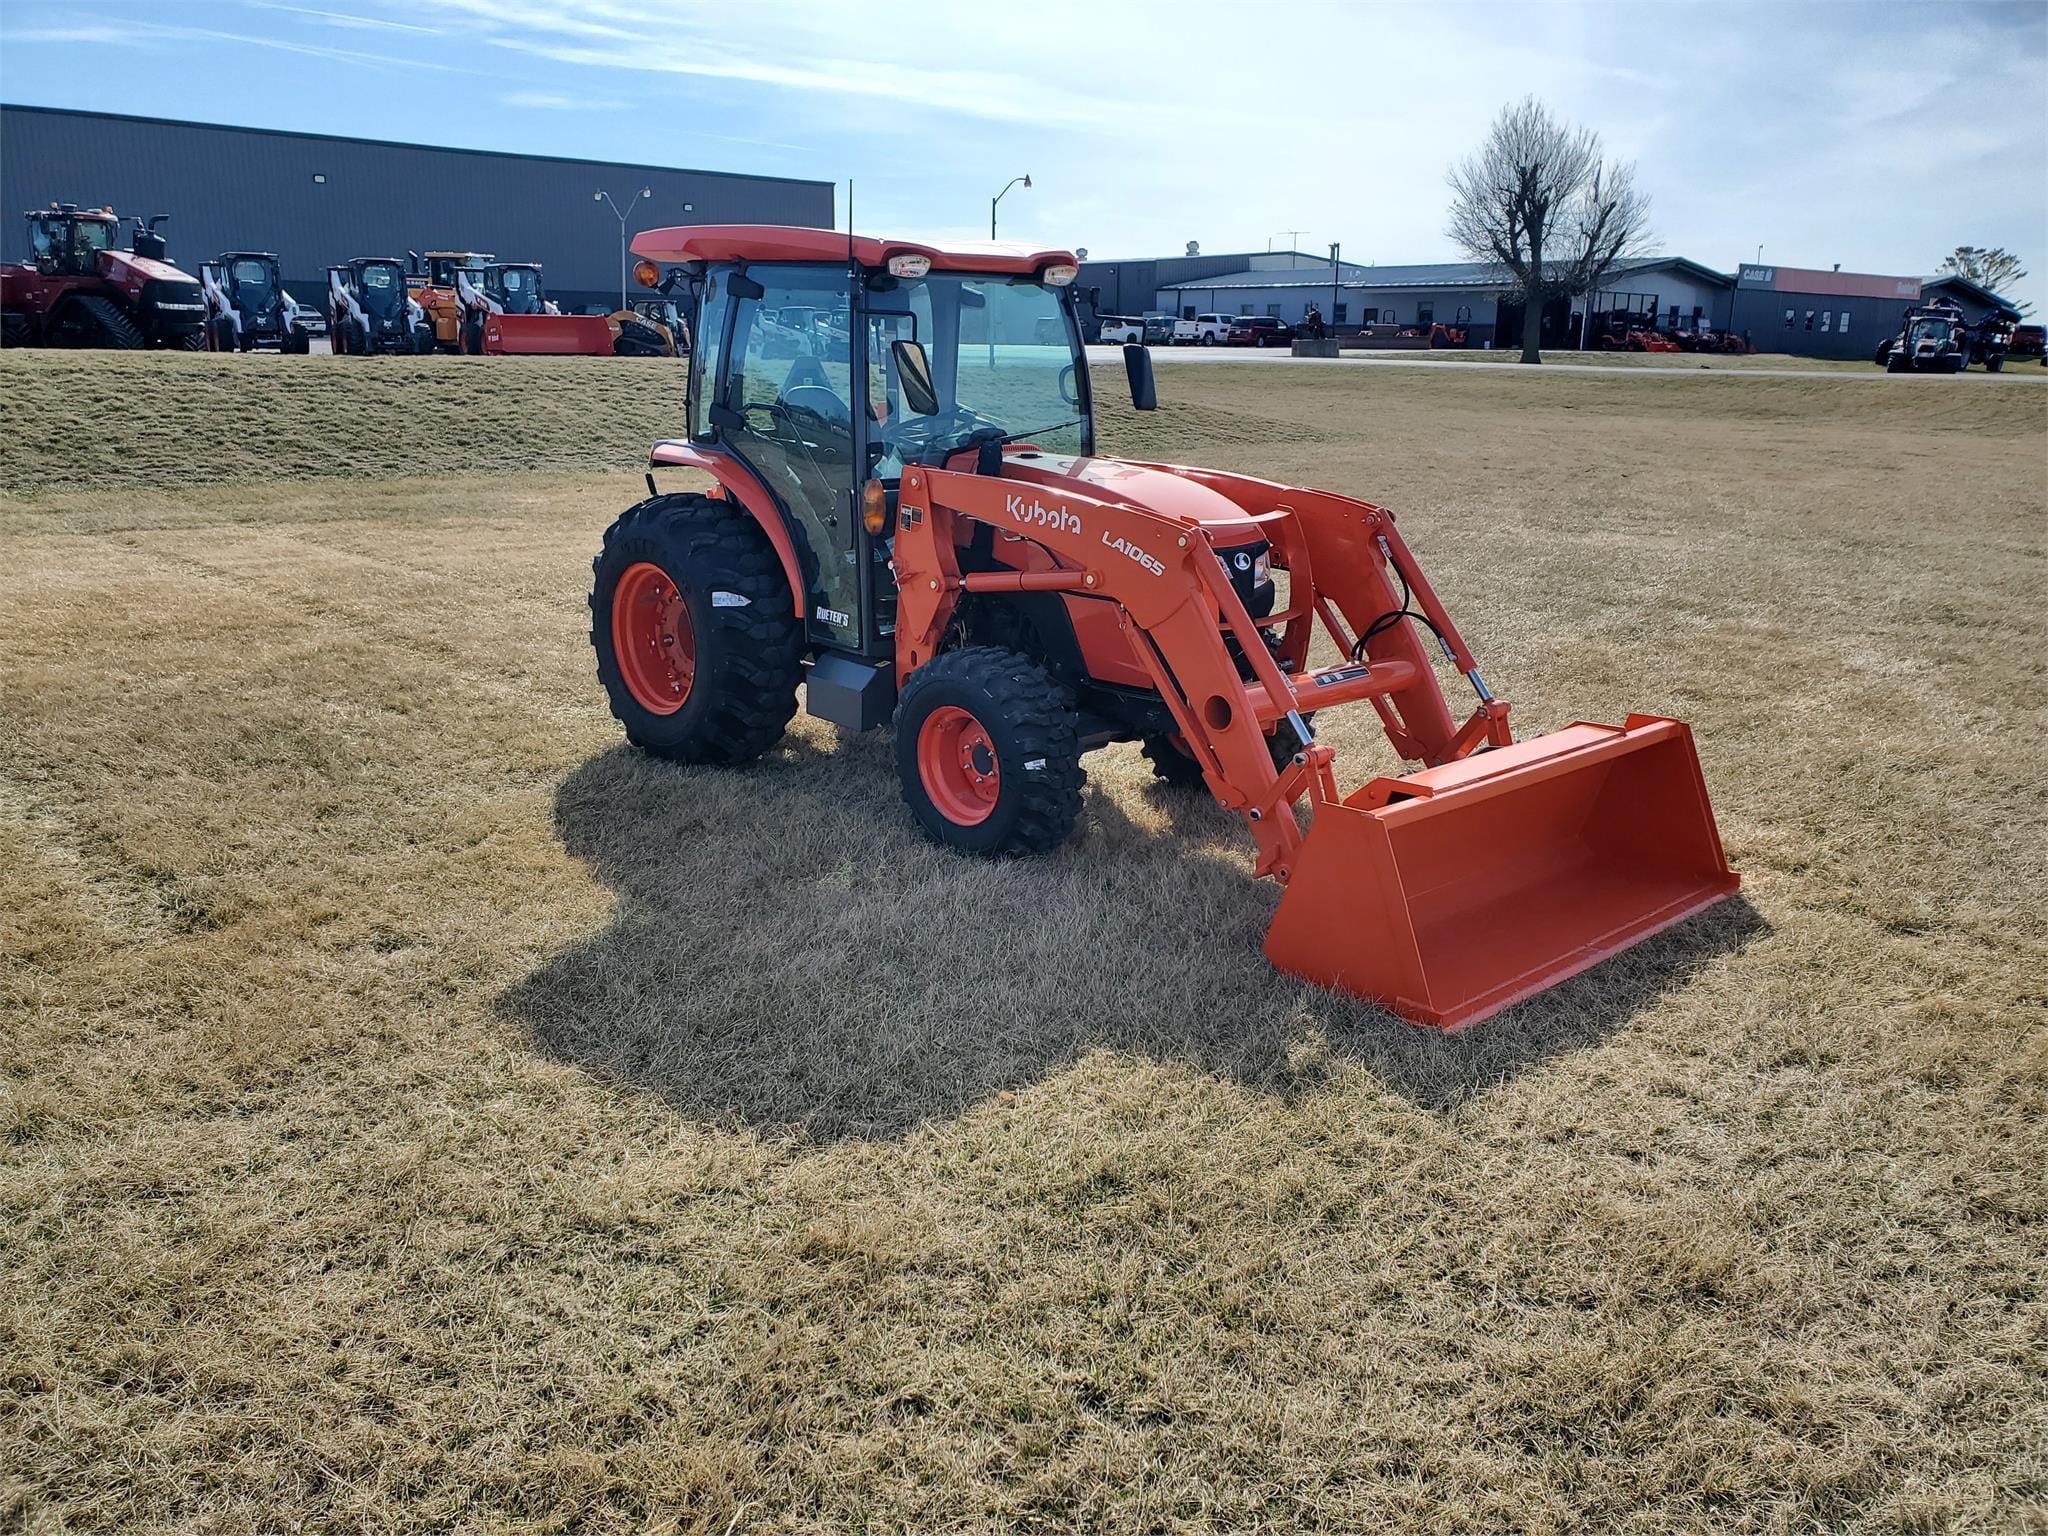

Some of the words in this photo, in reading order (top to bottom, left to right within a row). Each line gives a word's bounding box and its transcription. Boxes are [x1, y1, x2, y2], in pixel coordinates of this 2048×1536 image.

[1744, 269, 1765, 281] CASE
[635, 316, 657, 331] CASE
[1006, 494, 1081, 535] Kubota
[1101, 531, 1167, 577] LA1065
[816, 605, 849, 627] RUETER'S
